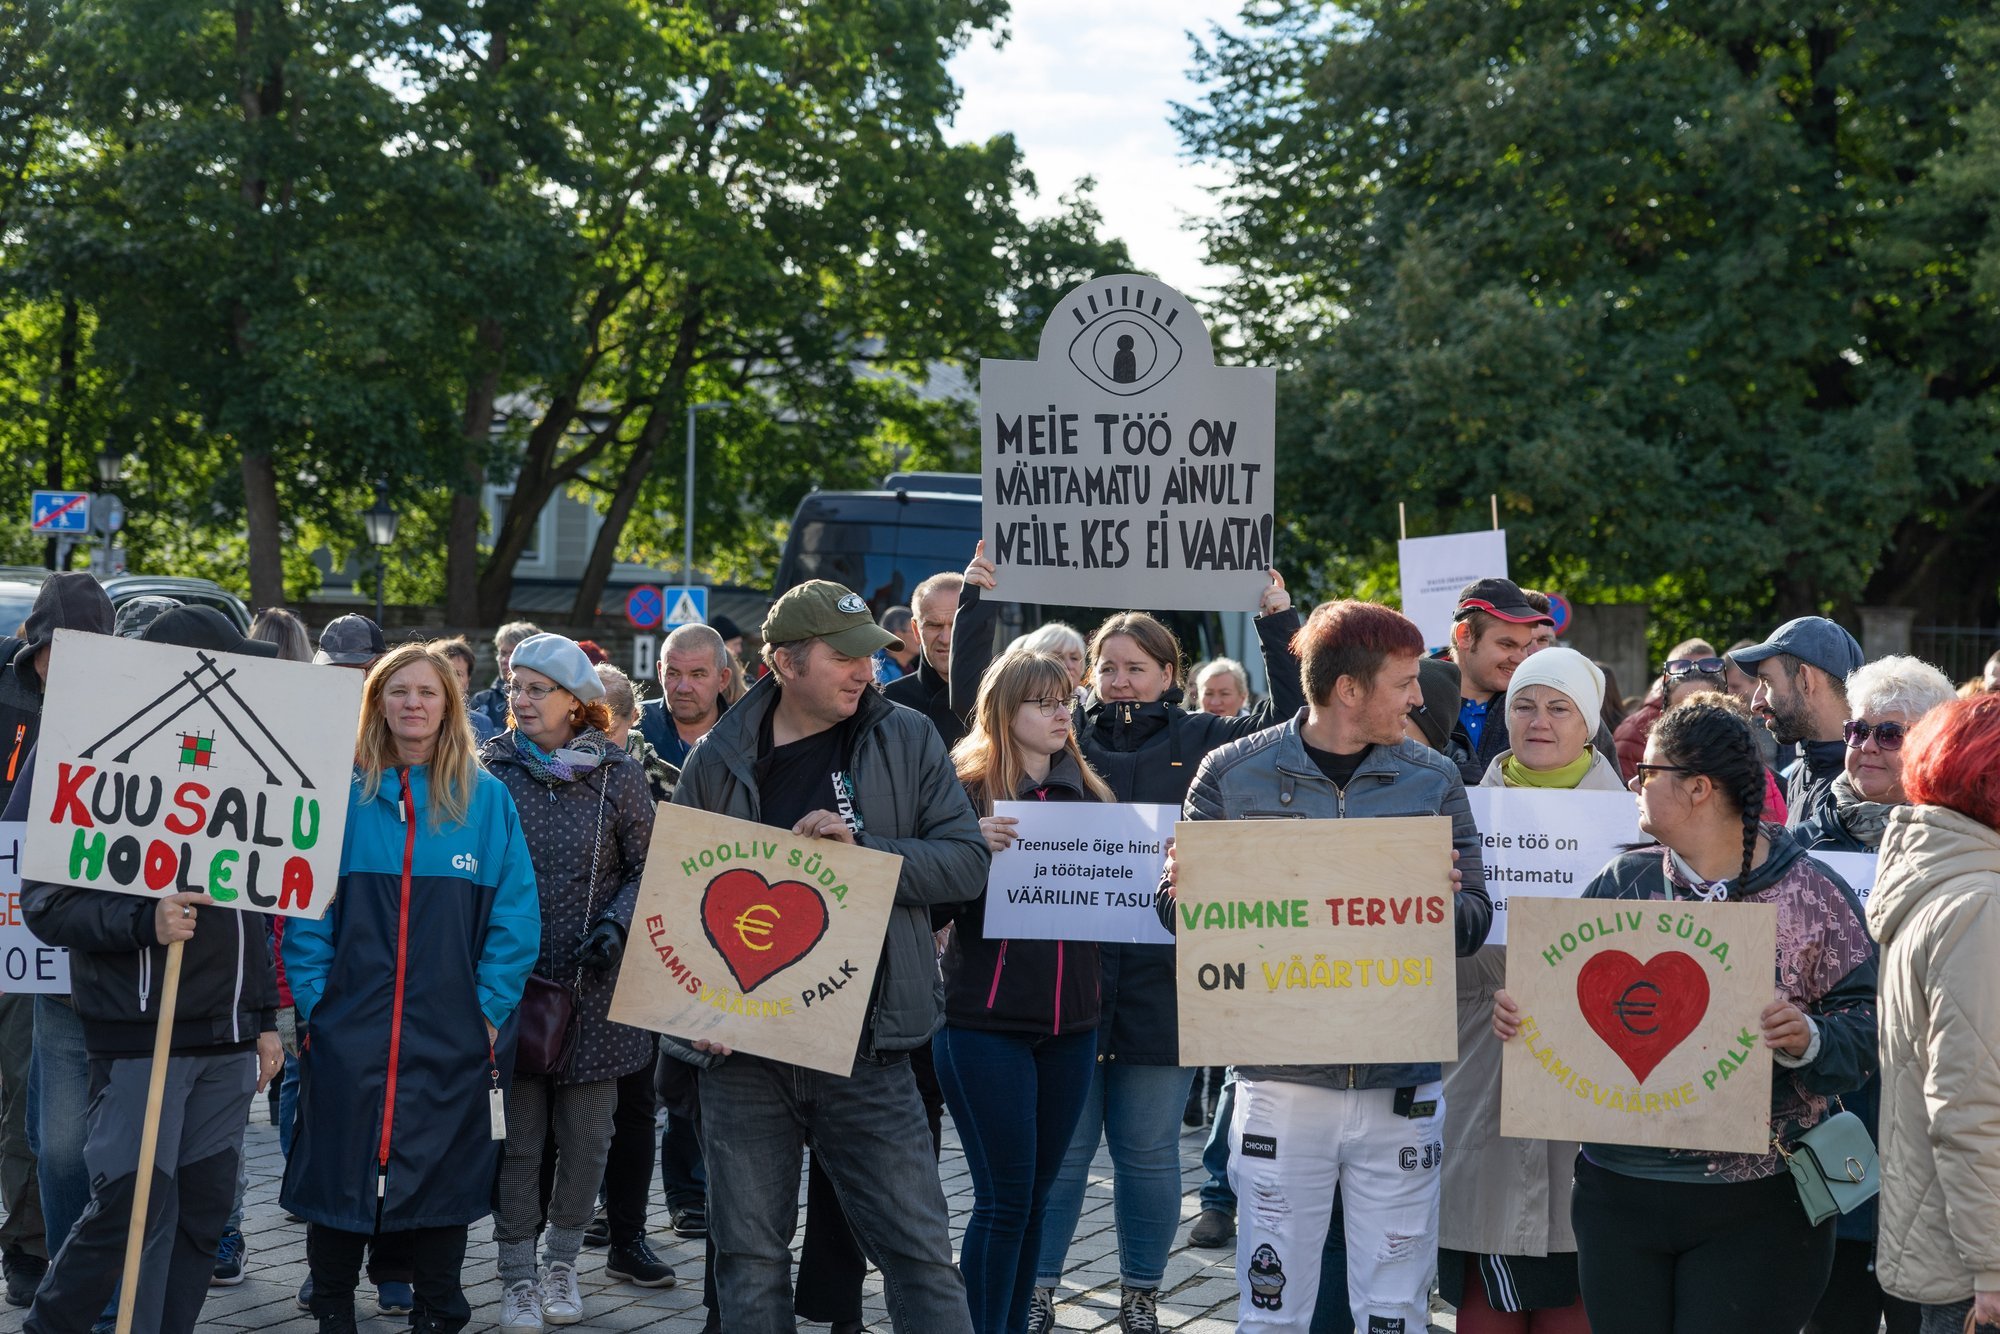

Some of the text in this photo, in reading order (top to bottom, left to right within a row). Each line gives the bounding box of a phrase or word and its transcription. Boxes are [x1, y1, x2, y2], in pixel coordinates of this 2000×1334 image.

[1094, 412, 1172, 456] TÖÖ
[1189, 418, 1237, 457] ON
[995, 460, 1150, 507] NÄHTAMATU
[1081, 519, 1129, 569] KES
[1178, 513, 1273, 571] VAATA!
[50, 762, 320, 850] KUUSALU
[1016, 838, 1160, 855] Teenusele õige hind
[1518, 833, 1549, 850] töö
[1555, 838, 1578, 850] on
[69, 828, 314, 910] HOOLELA
[680, 841, 850, 910] HOOLIV SÜDA,
[1033, 863, 1134, 880] ja töötajatele
[1007, 886, 1157, 908] VÄÄRILINE TASU!
[1179, 896, 1445, 930] VAIMNE TERVIS
[1541, 911, 1733, 971] HOOLIV SÜDA,
[801, 959, 860, 1008] PALK
[1198, 954, 1433, 991] ON VÄÄRTUS!
[1701, 1027, 1759, 1091] PALK
[1244, 1141, 1273, 1152] CHICKEN
